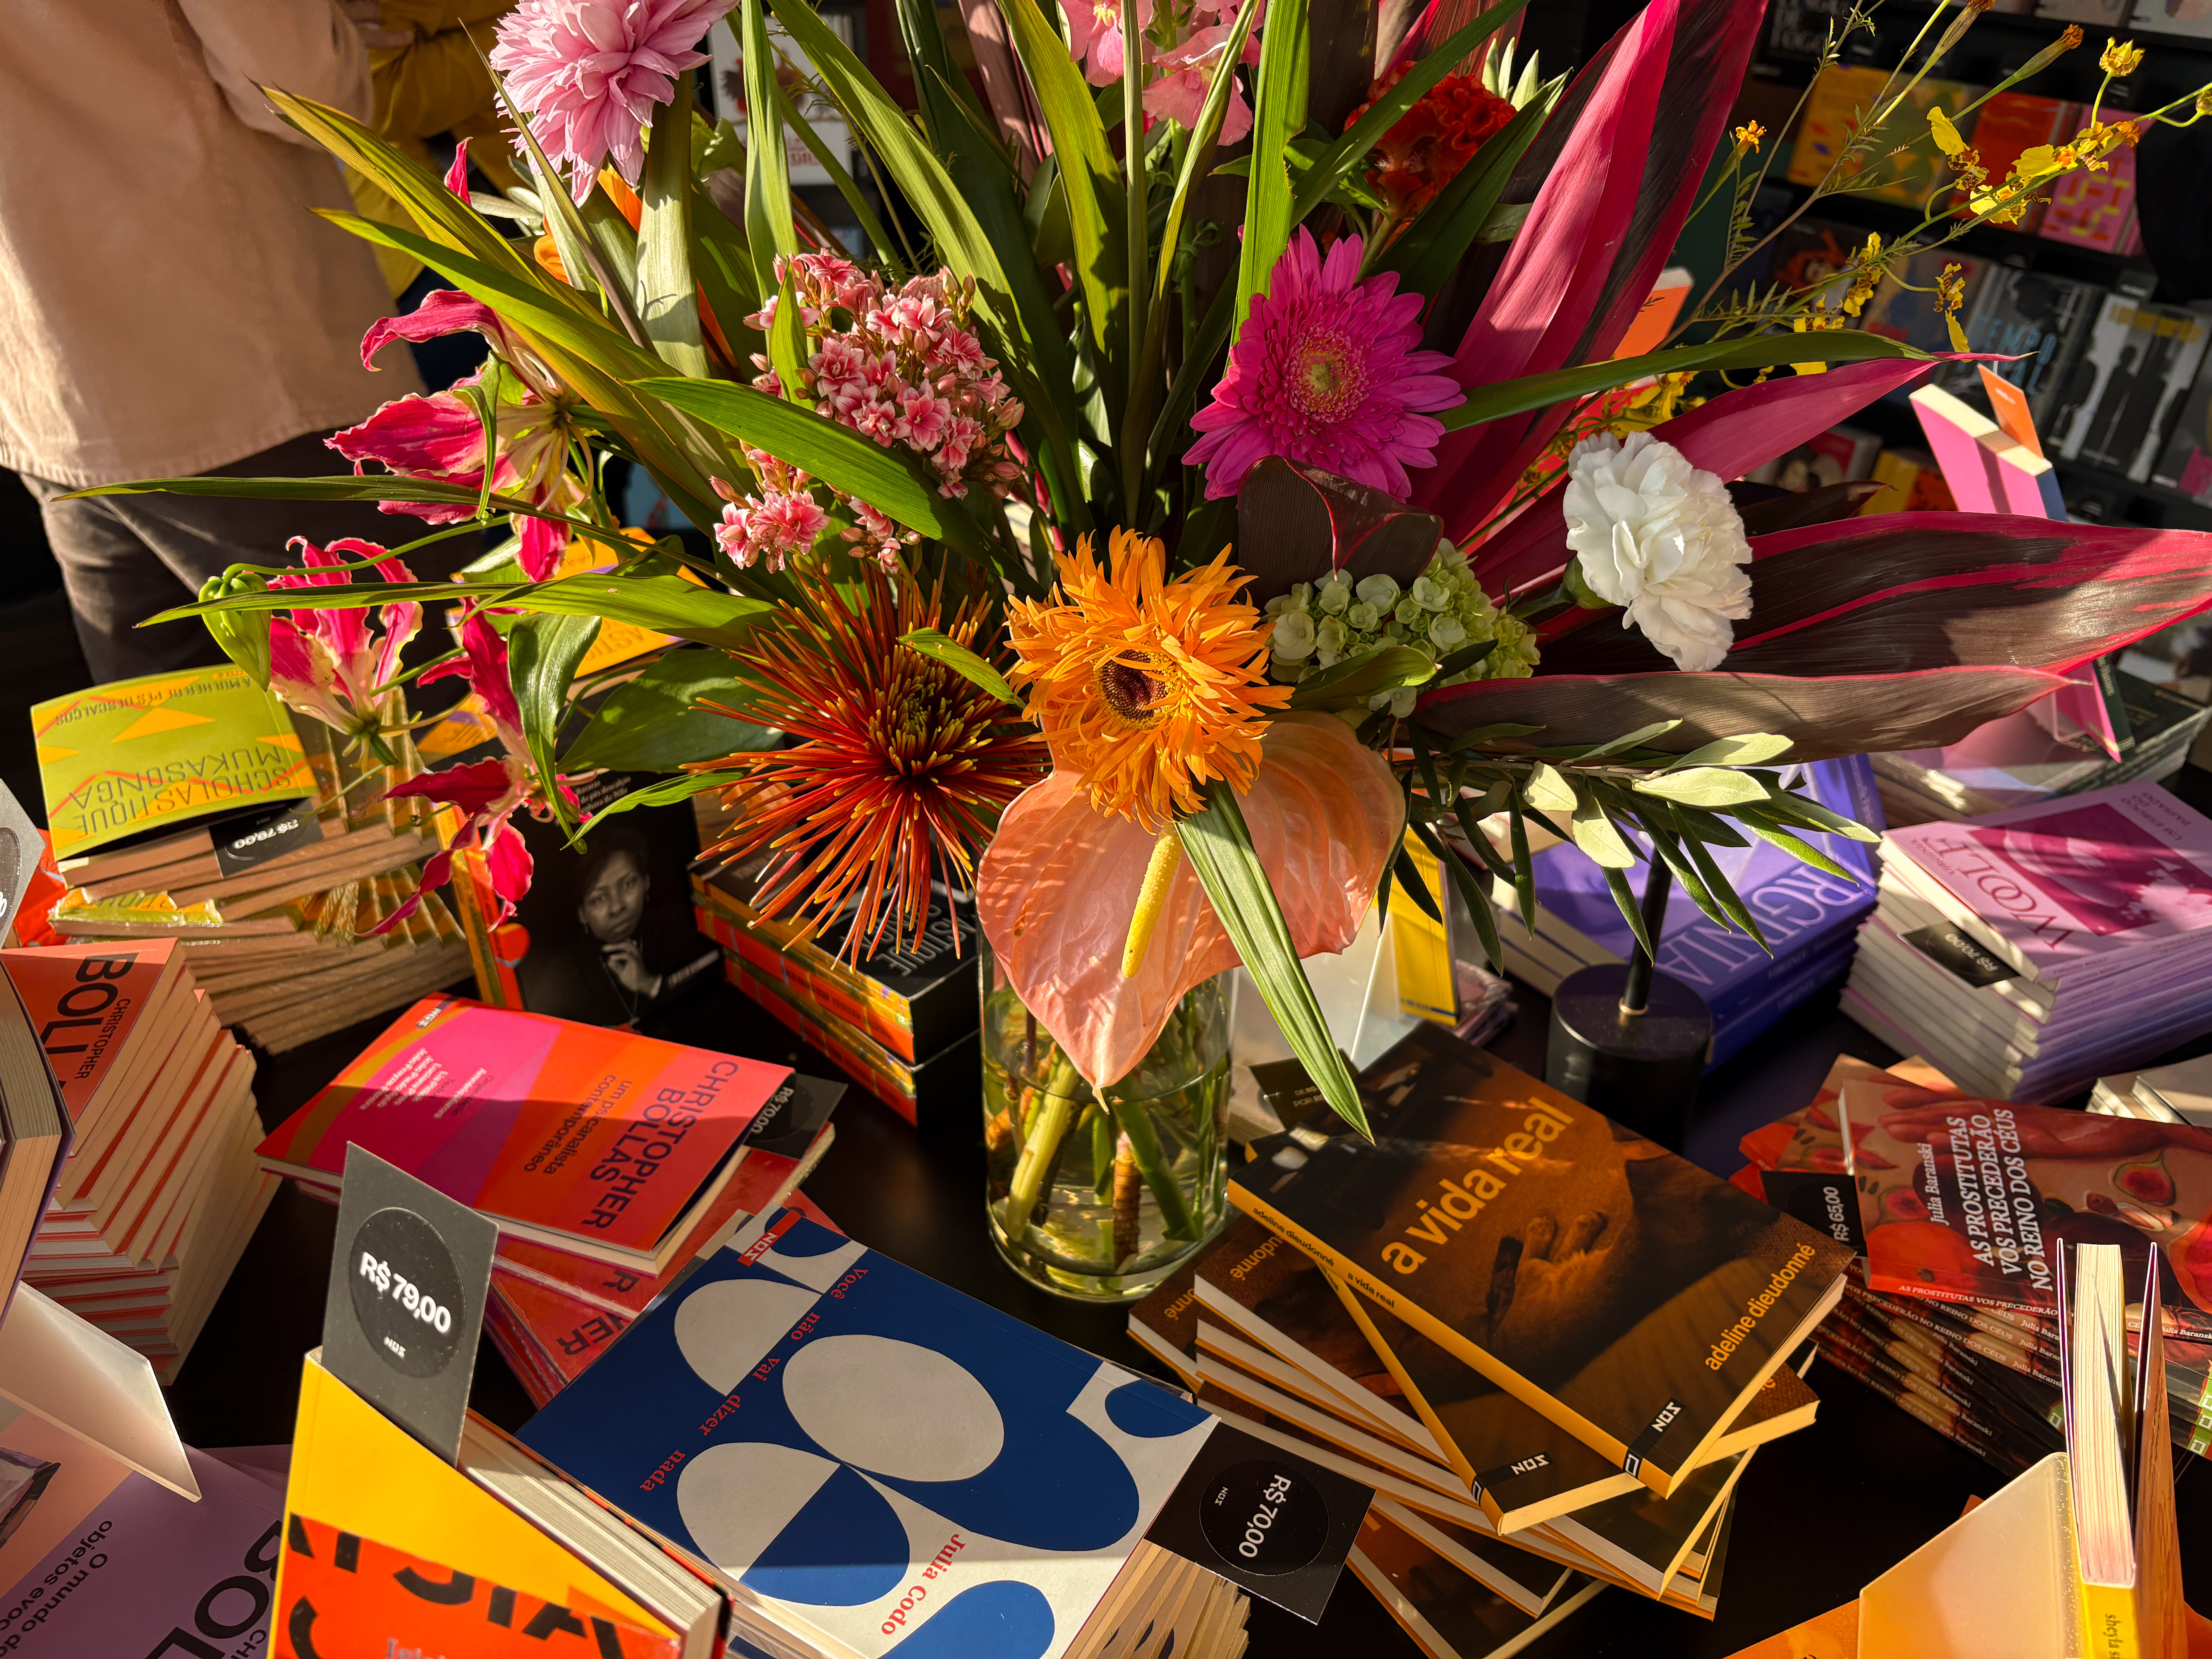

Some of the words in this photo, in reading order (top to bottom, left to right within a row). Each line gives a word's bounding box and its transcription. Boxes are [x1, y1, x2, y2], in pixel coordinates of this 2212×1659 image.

[69, 746, 281, 809] MUKASONGA
[73, 767, 291, 836] SCHOLASTIQUE
[1925, 836, 2075, 951] WOOLF
[74, 998, 131, 1079] CHRISTOPHER
[610, 1079, 634, 1101] um
[524, 1074, 616, 1172] contemporâneo
[544, 1097, 616, 1175] psicanalista
[582, 1061, 739, 1229] CHRISTOPHER
[590, 1087, 685, 1182] BOLLAS
[1994, 1108, 2021, 1153] CÉUS
[1381, 1242, 1427, 1274] a
[1405, 1169, 1507, 1245] vida
[1486, 1096, 1574, 1175] real
[1918, 1143, 1941, 1197] Baranski
[1947, 1116, 1989, 1239] PROSTITUTAS
[1971, 1115, 2014, 1235] PRECEDERÃO
[2007, 1156, 2031, 1195] DOS
[1834, 1222, 1850, 1242] R$
[1930, 1199, 1949, 1226] Julia
[2013, 1199, 2045, 1257] REINO
[1253, 1207, 1285, 1235] adeline
[1285, 1229, 1334, 1267] dieudonné
[1355, 1276, 1375, 1295] vida
[1375, 1290, 1395, 1308] real
[1970, 1240, 1995, 1266] AS
[1995, 1235, 2022, 1274] VOS
[2027, 1258, 2053, 1292] NO
[359, 1251, 392, 1293] R$
[392, 1273, 452, 1334] 79,00
[830, 1267, 869, 1300] Você
[1704, 1315, 1756, 1371] adeline
[1747, 1242, 1816, 1319] dieudonné
[1913, 1287, 1974, 1302] PROSTITUTAS
[1976, 1297, 1995, 1305] VOS
[1996, 1301, 2058, 1315] PRECEDERÃO
[791, 1312, 820, 1341] não
[1934, 1324, 1962, 1341] REINO
[1940, 1303, 1968, 1320] REINO
[752, 1358, 781, 1382] vai
[699, 1395, 741, 1436] dizer
[639, 1449, 686, 1492] nada
[1263, 1475, 1291, 1503] R$
[43, 1520, 113, 1586] objetos
[1238, 1504, 1278, 1558] 70,00
[89, 1553, 108, 1569] O
[922, 1534, 966, 1580] Julia
[21, 1569, 89, 1632] mundo
[881, 1585, 927, 1635] Codo
[2103, 1613, 2124, 1648] sheyla
